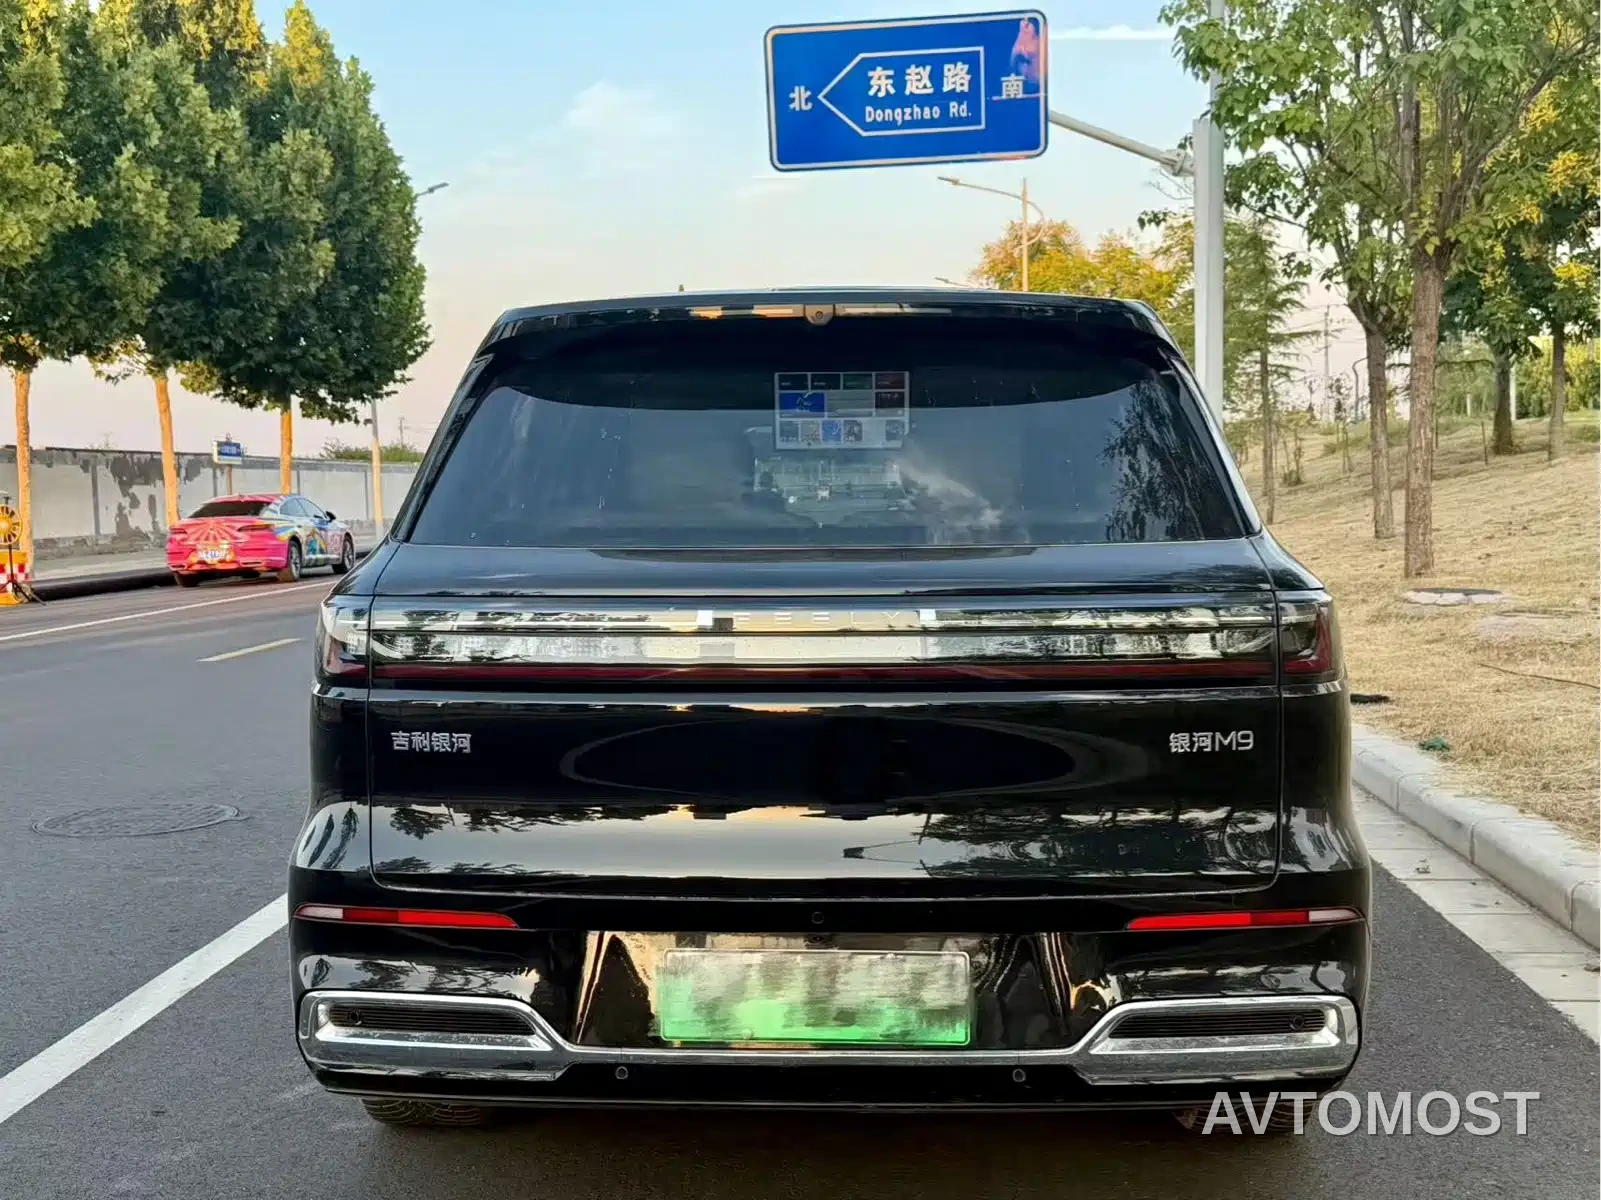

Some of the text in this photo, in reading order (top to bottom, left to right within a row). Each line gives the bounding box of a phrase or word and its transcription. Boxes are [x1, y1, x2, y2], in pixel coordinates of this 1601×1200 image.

[867, 61, 972, 98] 东赵路
[1001, 72, 1025, 99] 南
[789, 86, 812, 111] 北
[865, 101, 972, 126] Dongzhao Rd.
[390, 731, 472, 753] 吉利银河
[1169, 730, 1254, 753] 银河M9
